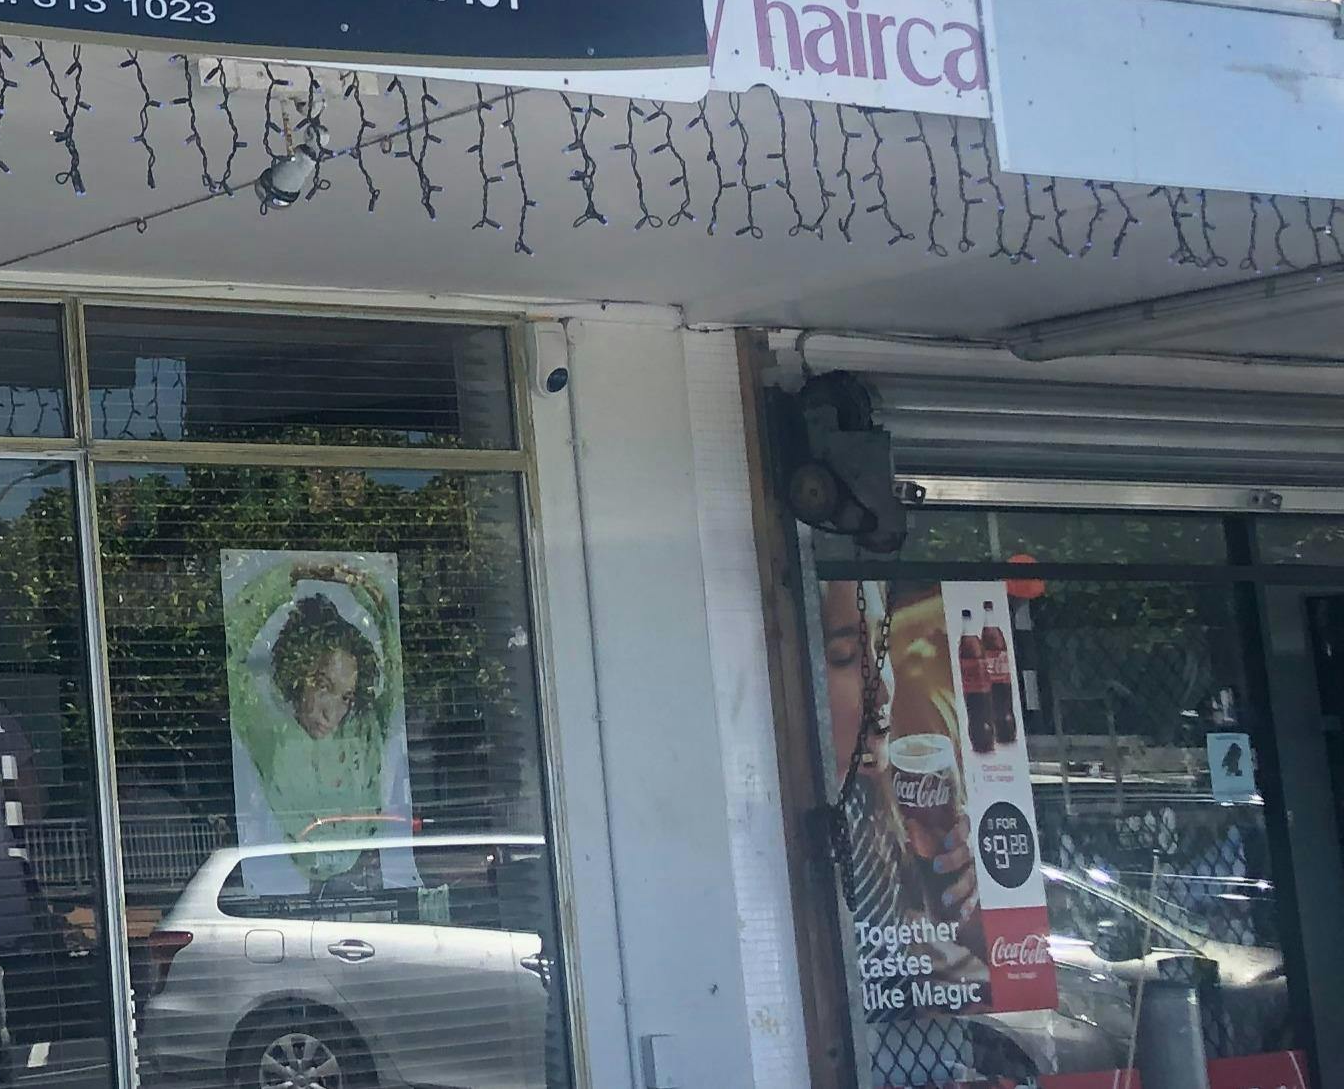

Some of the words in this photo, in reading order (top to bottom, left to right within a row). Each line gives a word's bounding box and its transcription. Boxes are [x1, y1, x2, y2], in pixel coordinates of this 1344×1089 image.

[995, 817, 1018, 830] FOR
[855, 917, 960, 952] Together
[991, 934, 1050, 967] Coca-Cola
[859, 951, 933, 979] tastes
[862, 983, 905, 1011] like
[912, 977, 982, 1010] Magic
